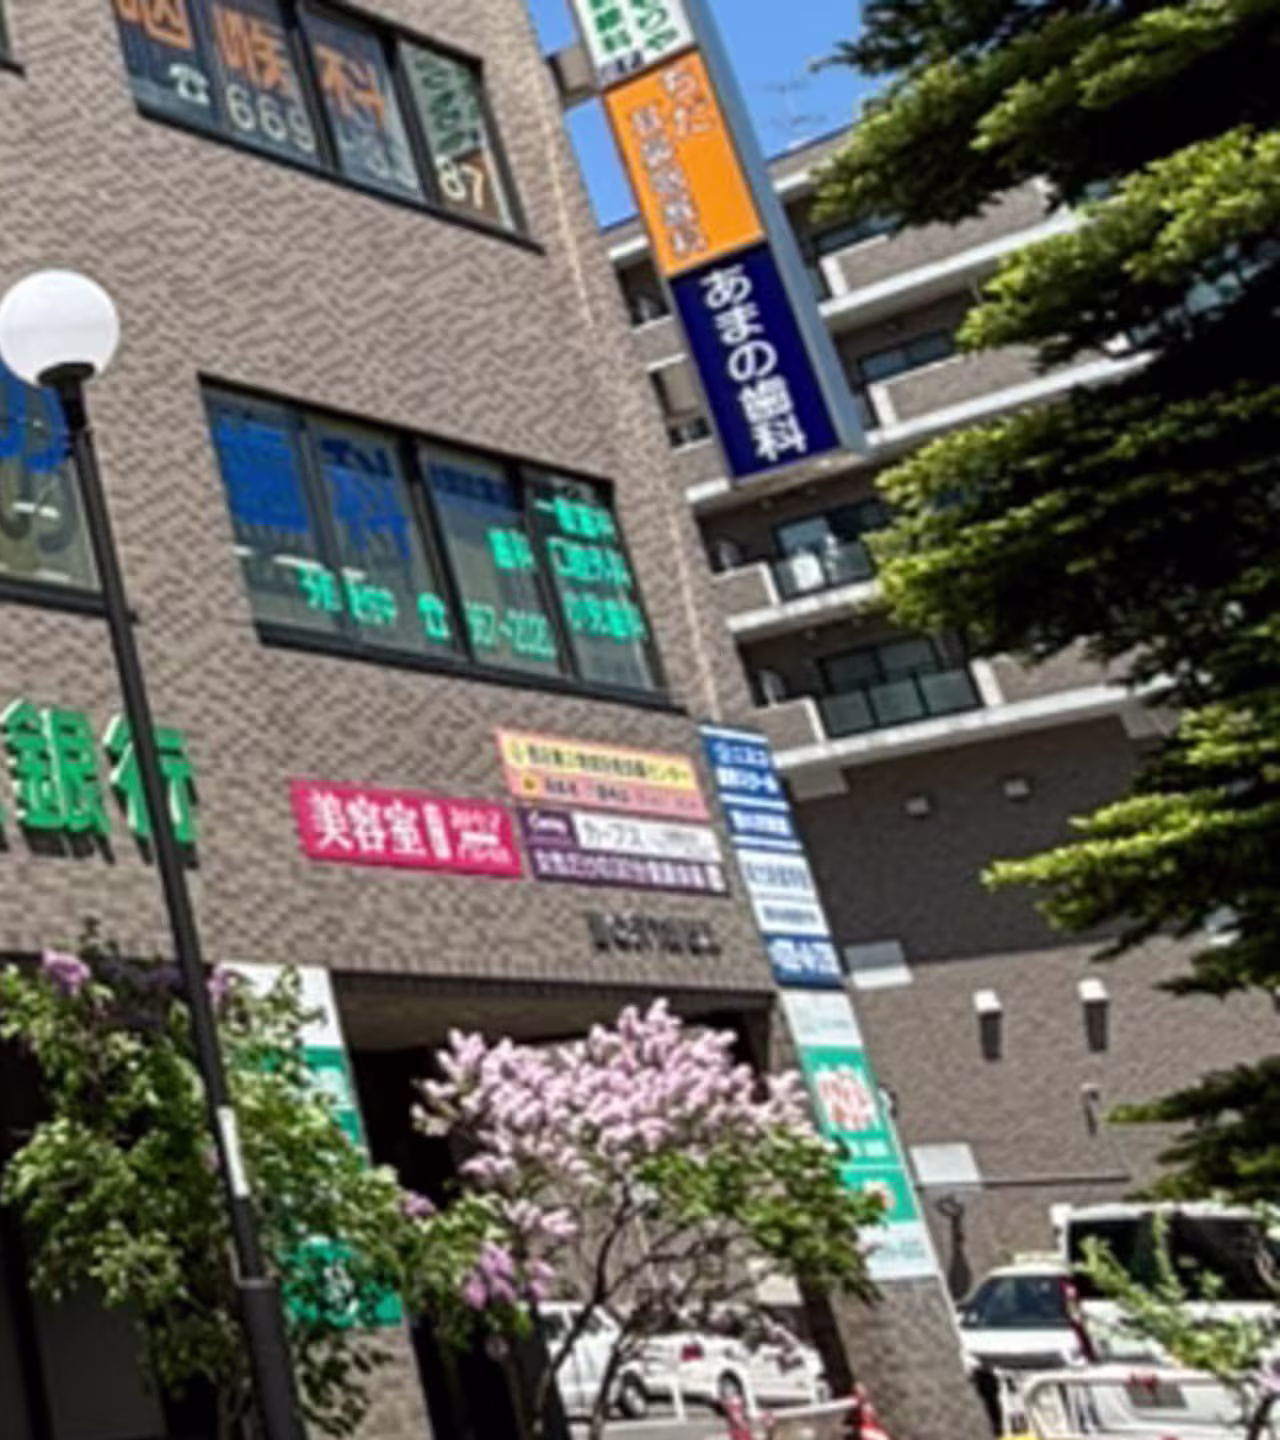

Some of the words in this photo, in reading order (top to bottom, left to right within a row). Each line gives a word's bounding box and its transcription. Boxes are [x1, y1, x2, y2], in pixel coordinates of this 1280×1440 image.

[700, 264, 808, 462] あまの歯科
[307, 790, 428, 858] 美容室
